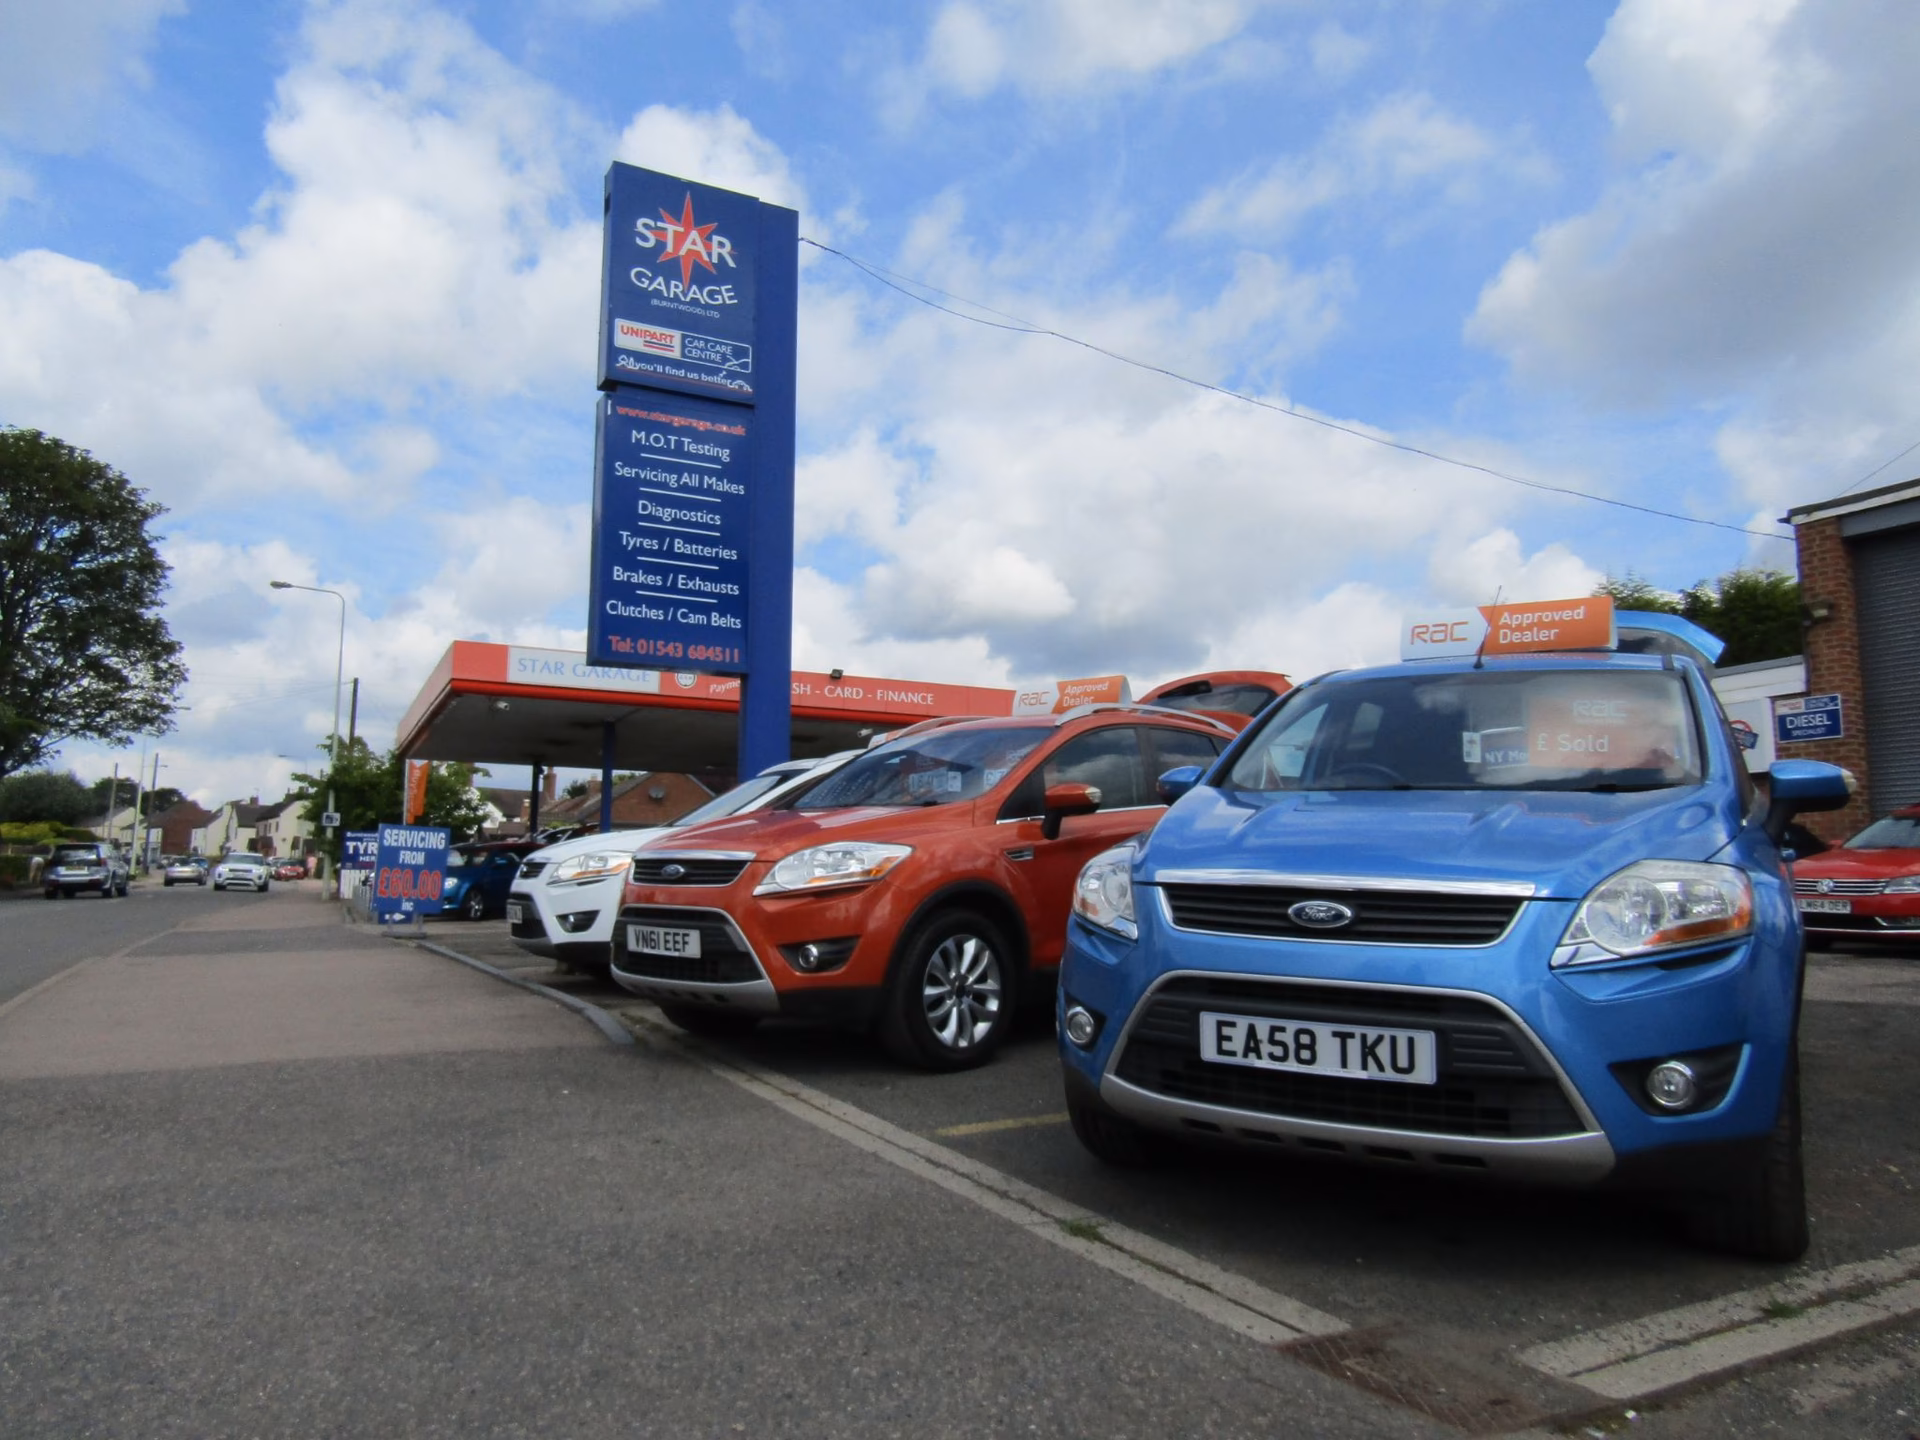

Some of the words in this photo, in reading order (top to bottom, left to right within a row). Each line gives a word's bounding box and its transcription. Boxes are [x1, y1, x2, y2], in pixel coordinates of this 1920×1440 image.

[635, 217, 737, 268] STAR
[630, 267, 738, 305] GARAGE
[706, 309, 720, 318] LTD
[620, 325, 675, 344] UNIPART
[684, 337, 706, 350] CAR
[707, 342, 733, 355] CARE
[684, 347, 722, 362] CENTRE
[665, 365, 685, 378] find
[687, 372, 699, 380] us
[680, 437, 730, 462] Testing
[615, 461, 678, 488] Servicing
[680, 472, 699, 488] All
[704, 475, 745, 495] Makes
[638, 500, 721, 525] Diagnostics
[619, 530, 659, 551] Tyres
[674, 538, 737, 561] Batteries
[613, 566, 662, 586] Brakes
[677, 574, 740, 596] Exhausts
[606, 600, 664, 621] Clutches
[677, 609, 707, 626] Cam
[711, 613, 742, 630] Belts
[1499, 605, 1585, 628] Approved
[1499, 627, 1560, 644] Dealer
[608, 635, 635, 653] Tel:
[637, 640, 683, 658] 01543
[688, 646, 740, 665] 684511
[517, 657, 565, 676] STAR
[571, 663, 650, 683] GARAGE
[824, 685, 864, 700] CARD
[876, 689, 935, 705] FINANCE
[1064, 681, 1109, 696] Approved
[1062, 695, 1095, 707] Dealer
[1785, 712, 1833, 729] DIESEL
[1557, 734, 1610, 753] Sold
[346, 841, 378, 855] TYR
[383, 829, 446, 850] SERVICING
[399, 850, 425, 866] FROM
[378, 866, 443, 901] £60.00
[1301, 905, 1336, 921] Ford
[634, 928, 661, 950] VN61
[664, 931, 690, 952] EEF
[1215, 1019, 1317, 1066] EA58
[1331, 1030, 1416, 1075] TKU
